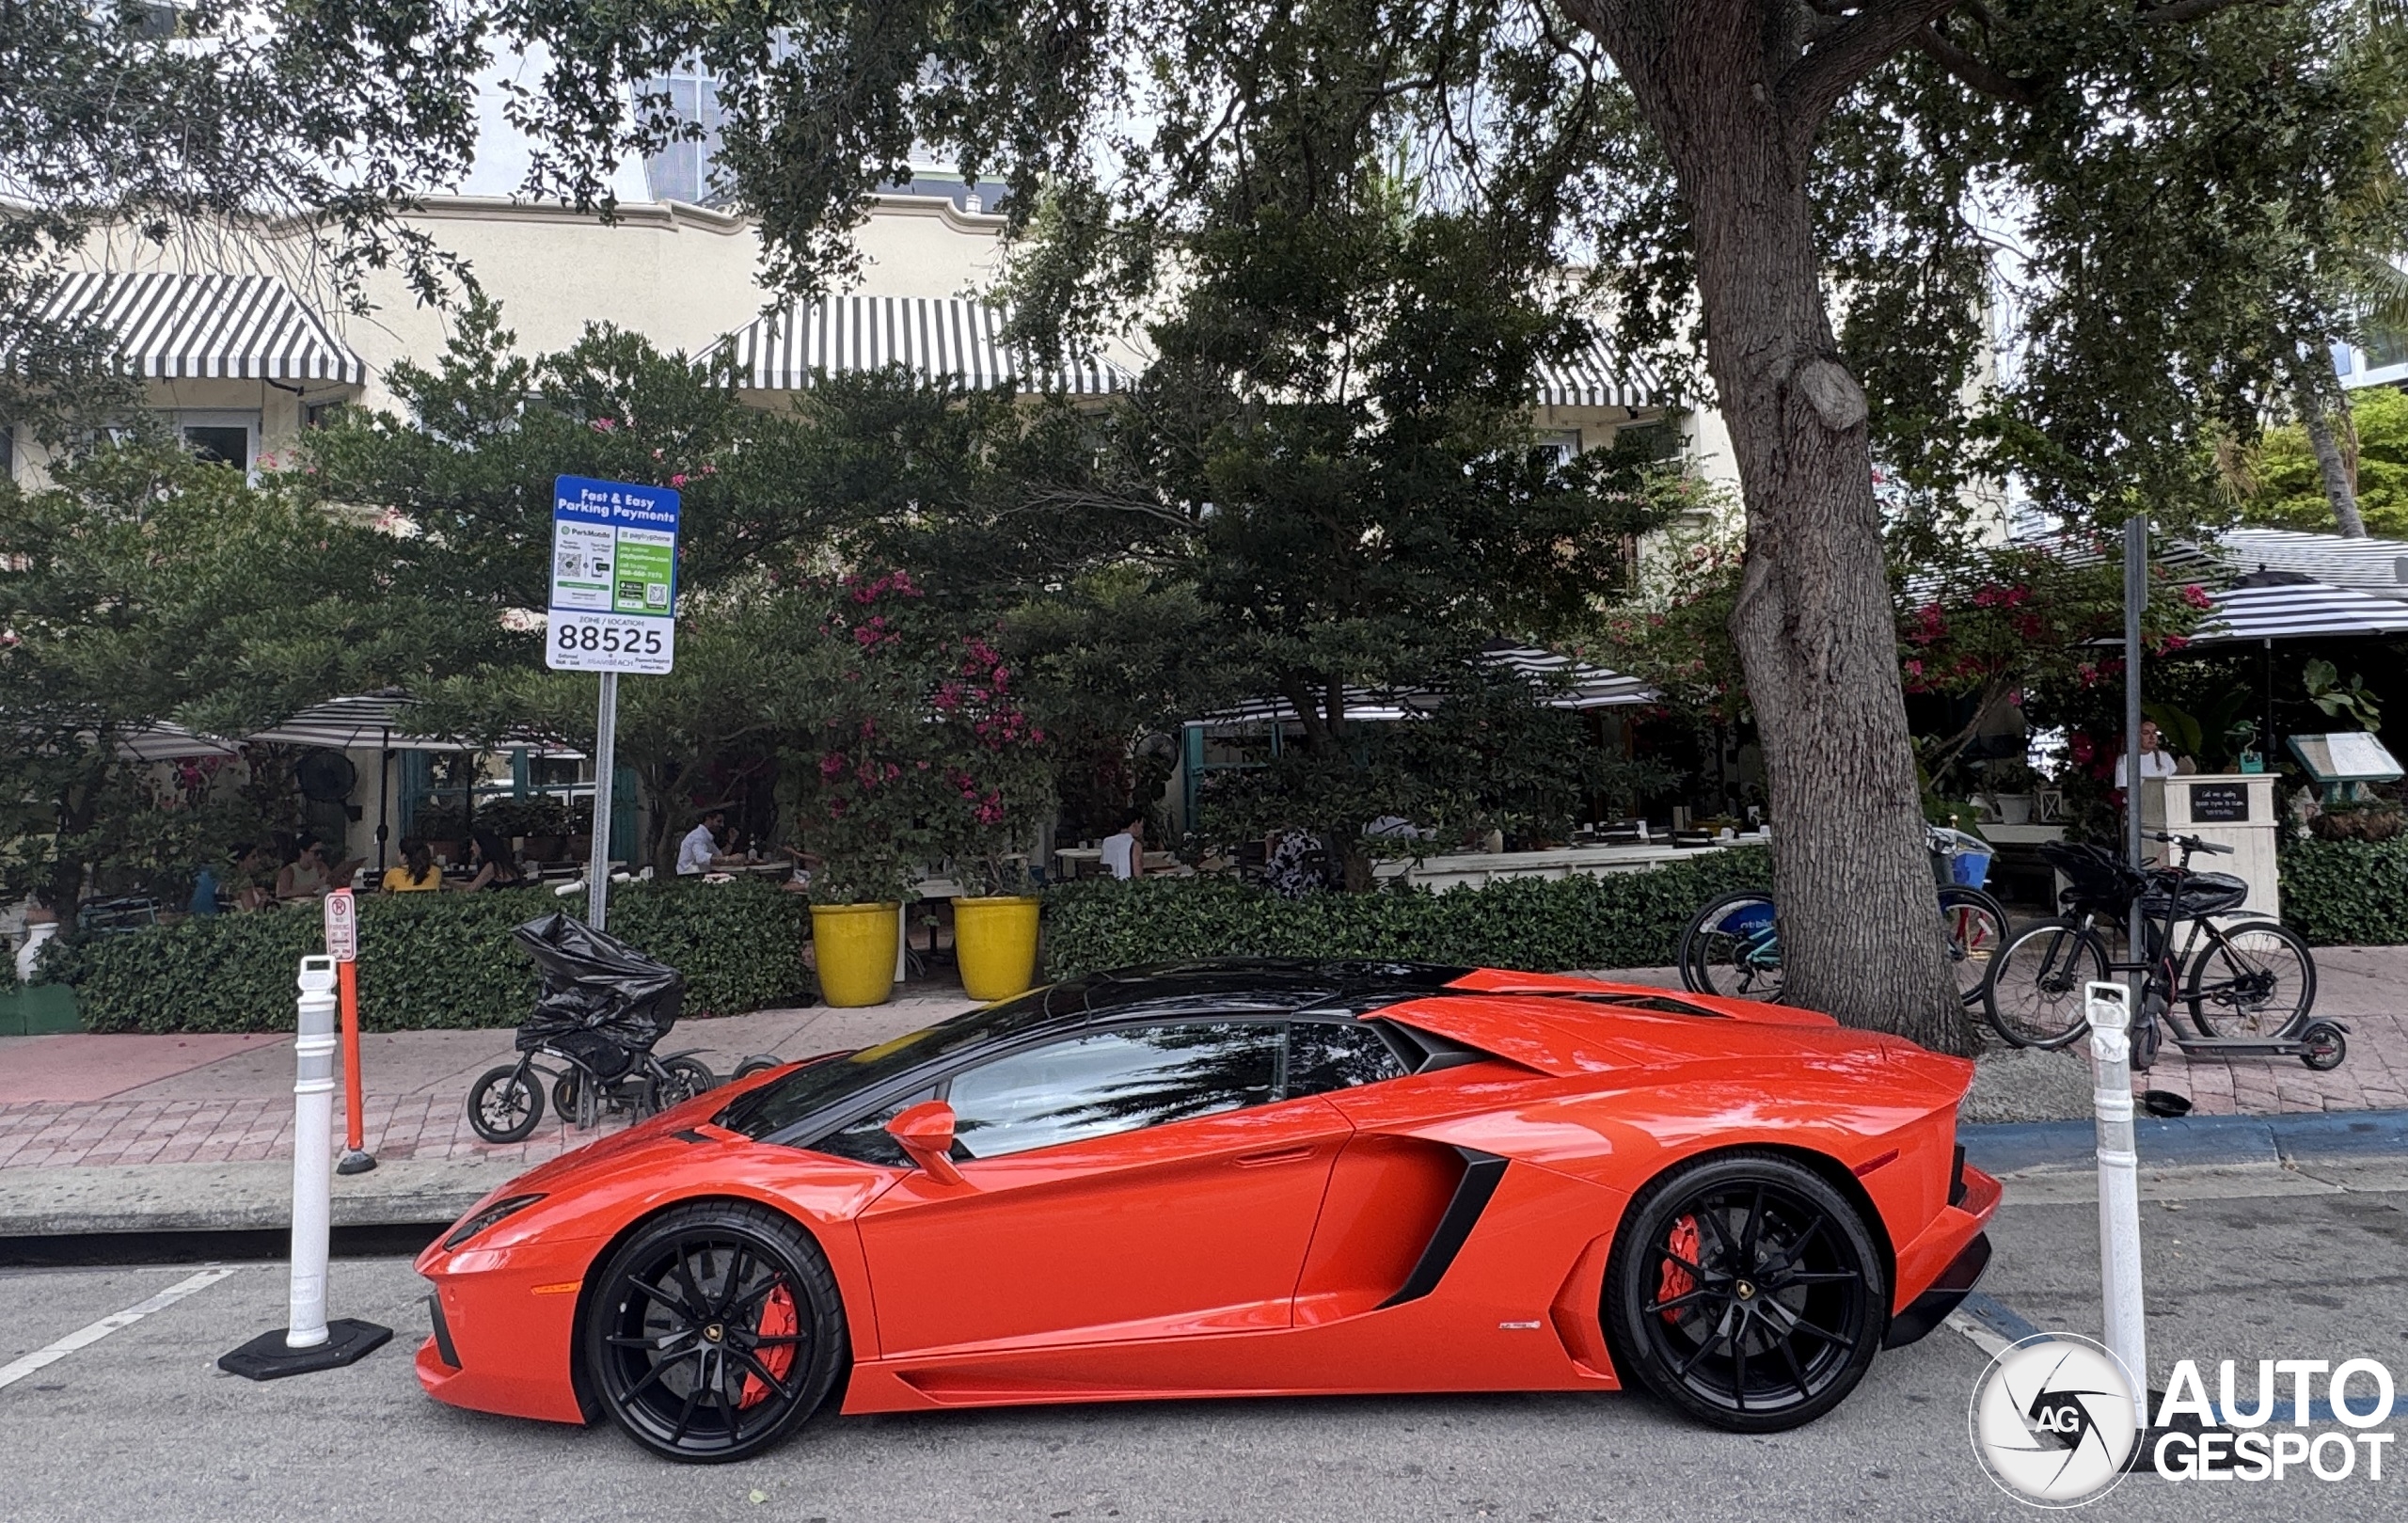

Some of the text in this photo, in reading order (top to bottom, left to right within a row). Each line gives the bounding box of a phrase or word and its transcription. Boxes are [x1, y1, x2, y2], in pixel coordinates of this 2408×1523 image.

[559, 498, 674, 523] Parking Payments
[581, 488, 655, 511] Fast & Easy
[579, 615, 600, 624] ZONE
[608, 617, 644, 627] LOCATION
[559, 624, 662, 655] 88525
